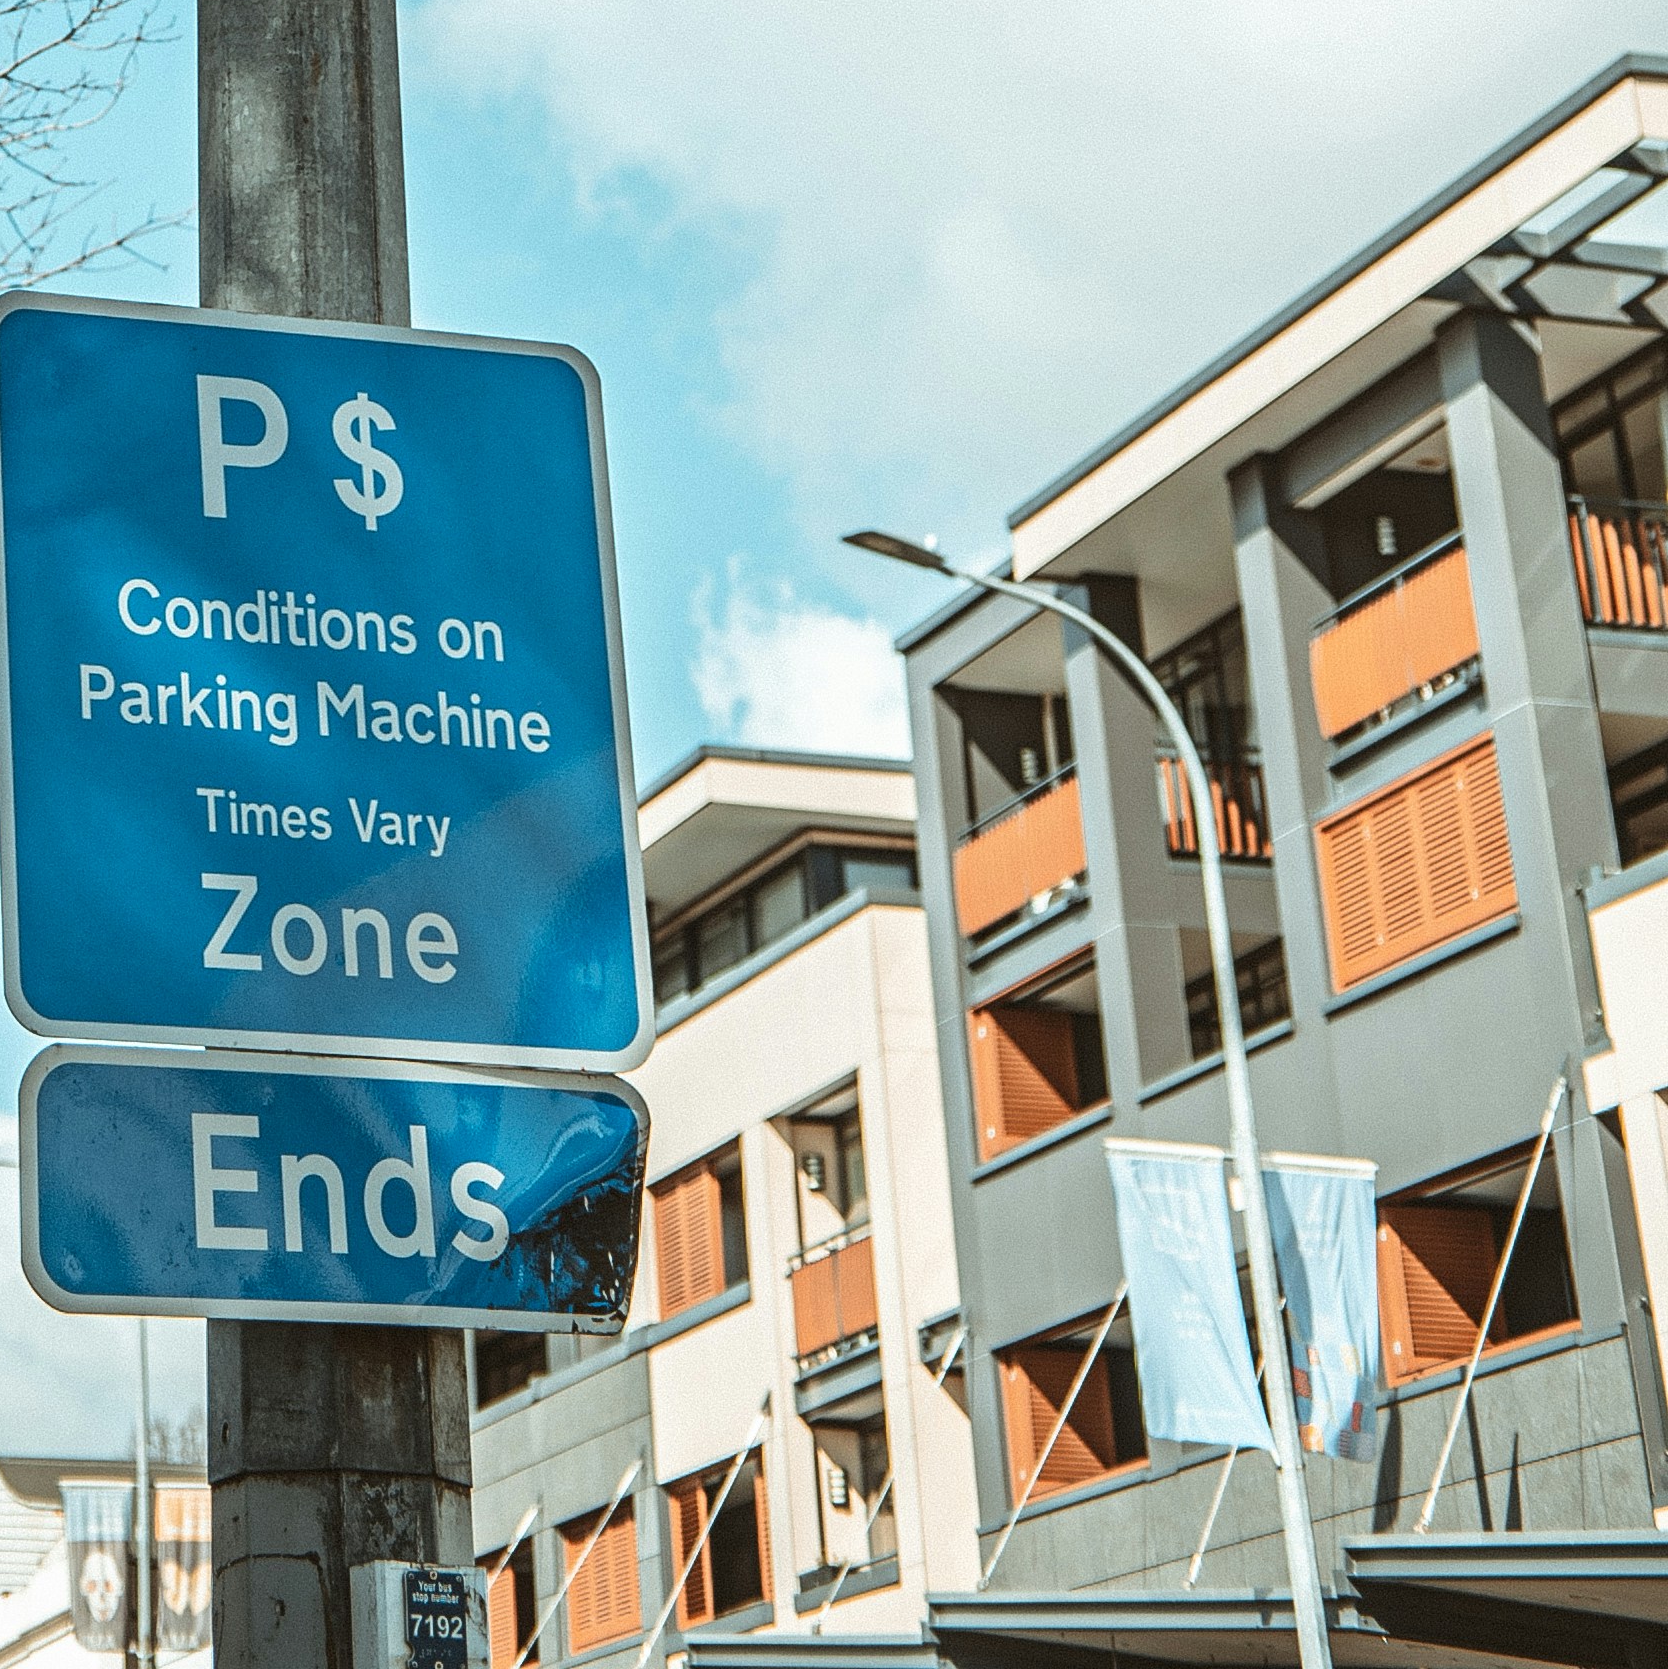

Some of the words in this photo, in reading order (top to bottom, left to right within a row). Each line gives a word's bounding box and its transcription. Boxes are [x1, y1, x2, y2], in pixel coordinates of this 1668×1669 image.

[195, 373, 290, 520] P
[332, 391, 406, 532] $
[117, 578, 417, 656] Conditions
[437, 614, 505, 663] on
[79, 663, 300, 748] Parking
[316, 680, 552, 755] Machine
[195, 786, 335, 841] Times
[346, 797, 451, 858] Vary
[201, 871, 460, 985] Zone
[190, 1111, 511, 1263] Ends
[410, 1613, 464, 1639] 7192
